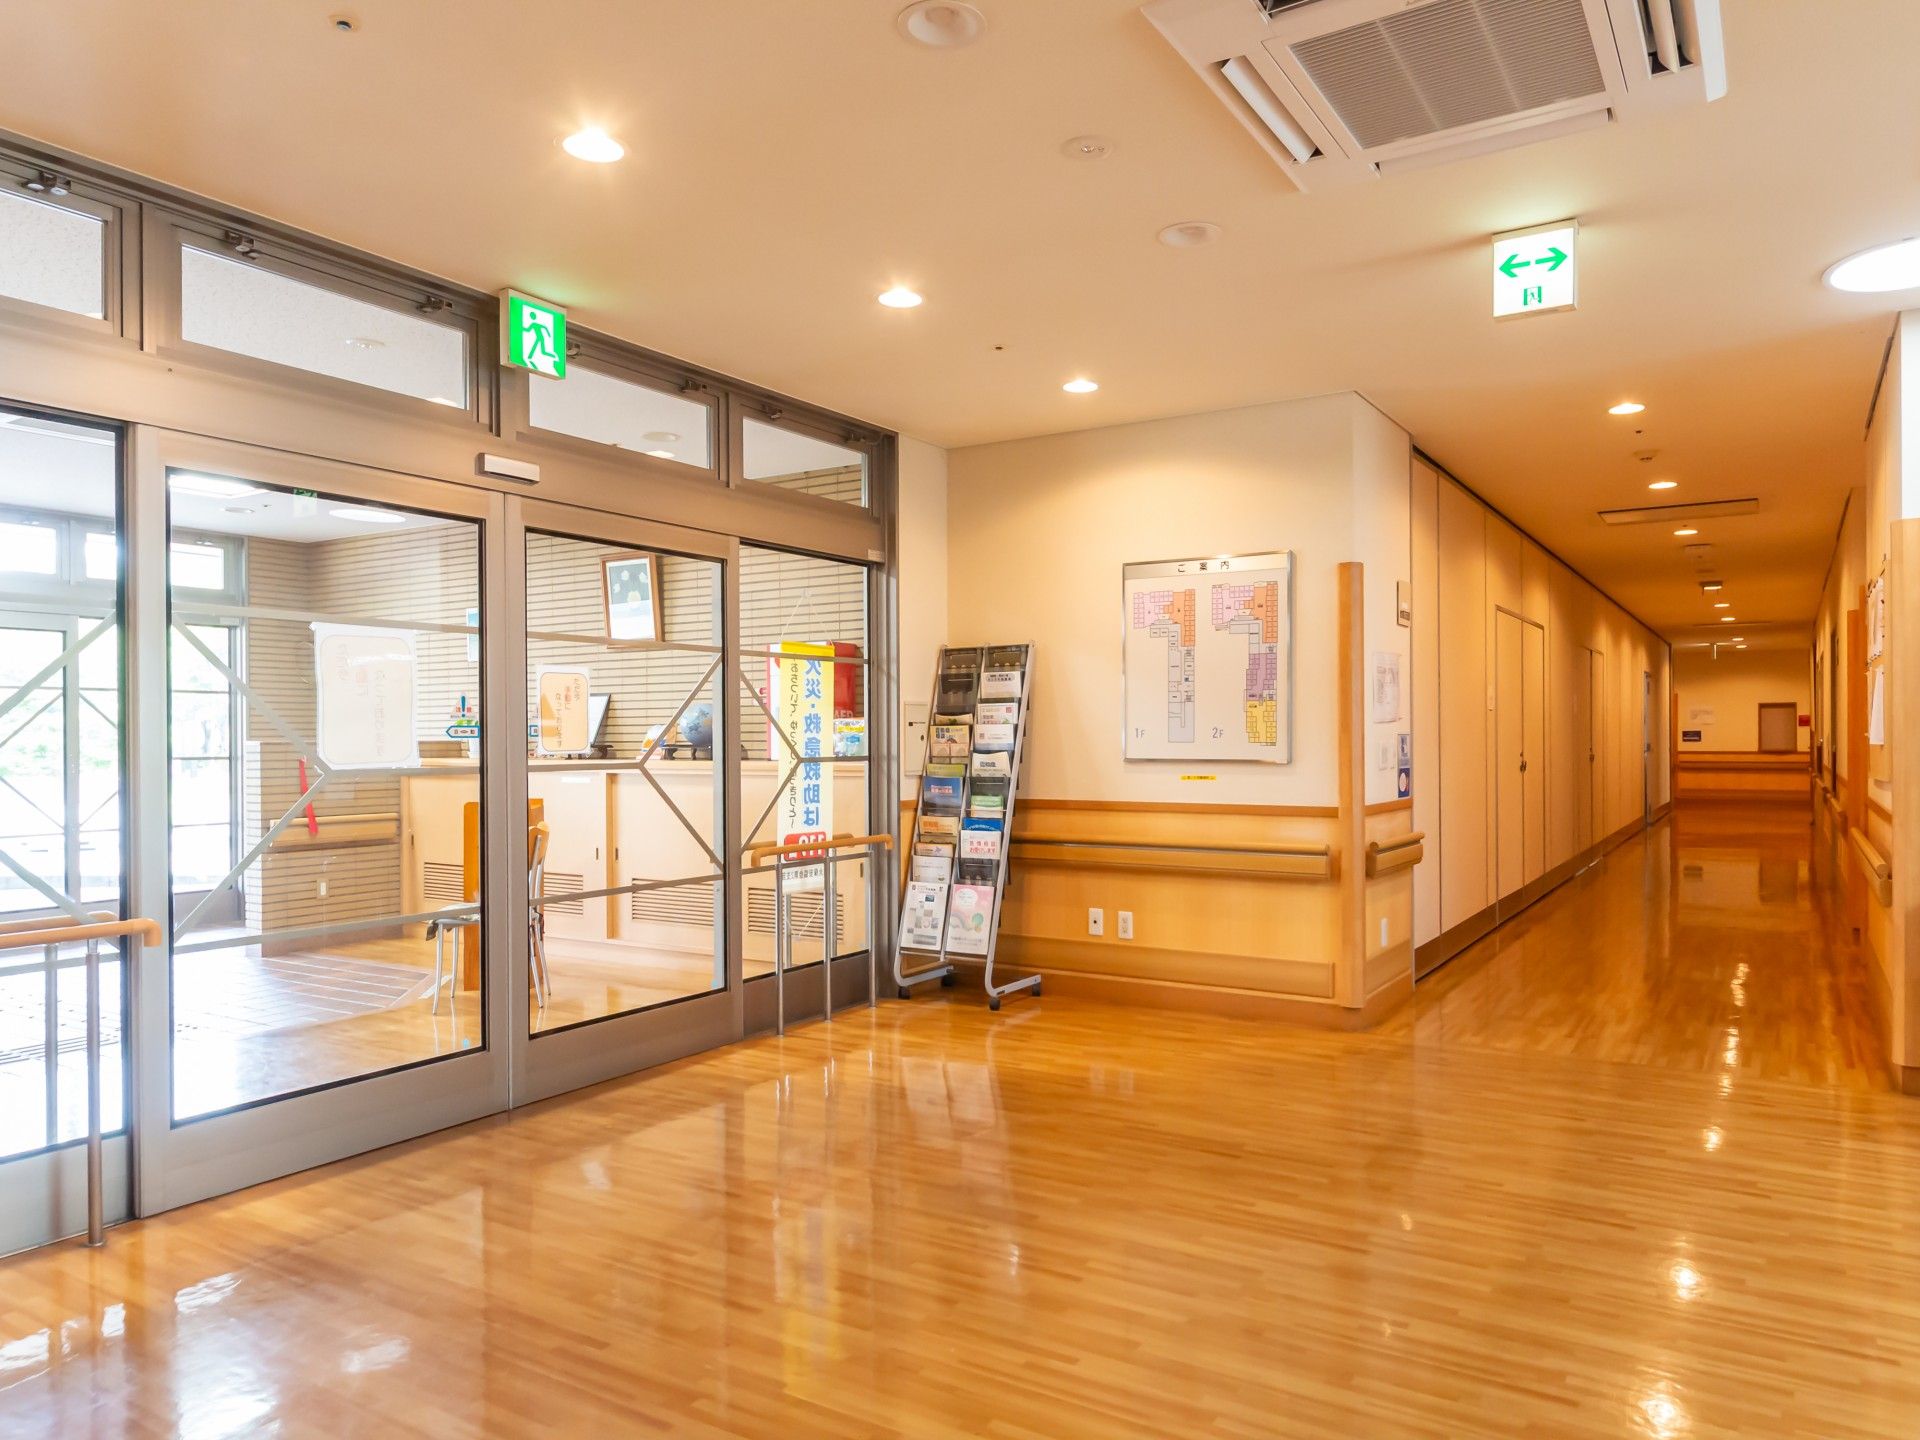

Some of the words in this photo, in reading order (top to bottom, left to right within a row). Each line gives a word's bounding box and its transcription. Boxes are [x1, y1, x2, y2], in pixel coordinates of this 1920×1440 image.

[1177, 560, 1230, 574] ご案内
[1135, 727, 1145, 739] 1F
[1212, 728, 1224, 739] 2F
